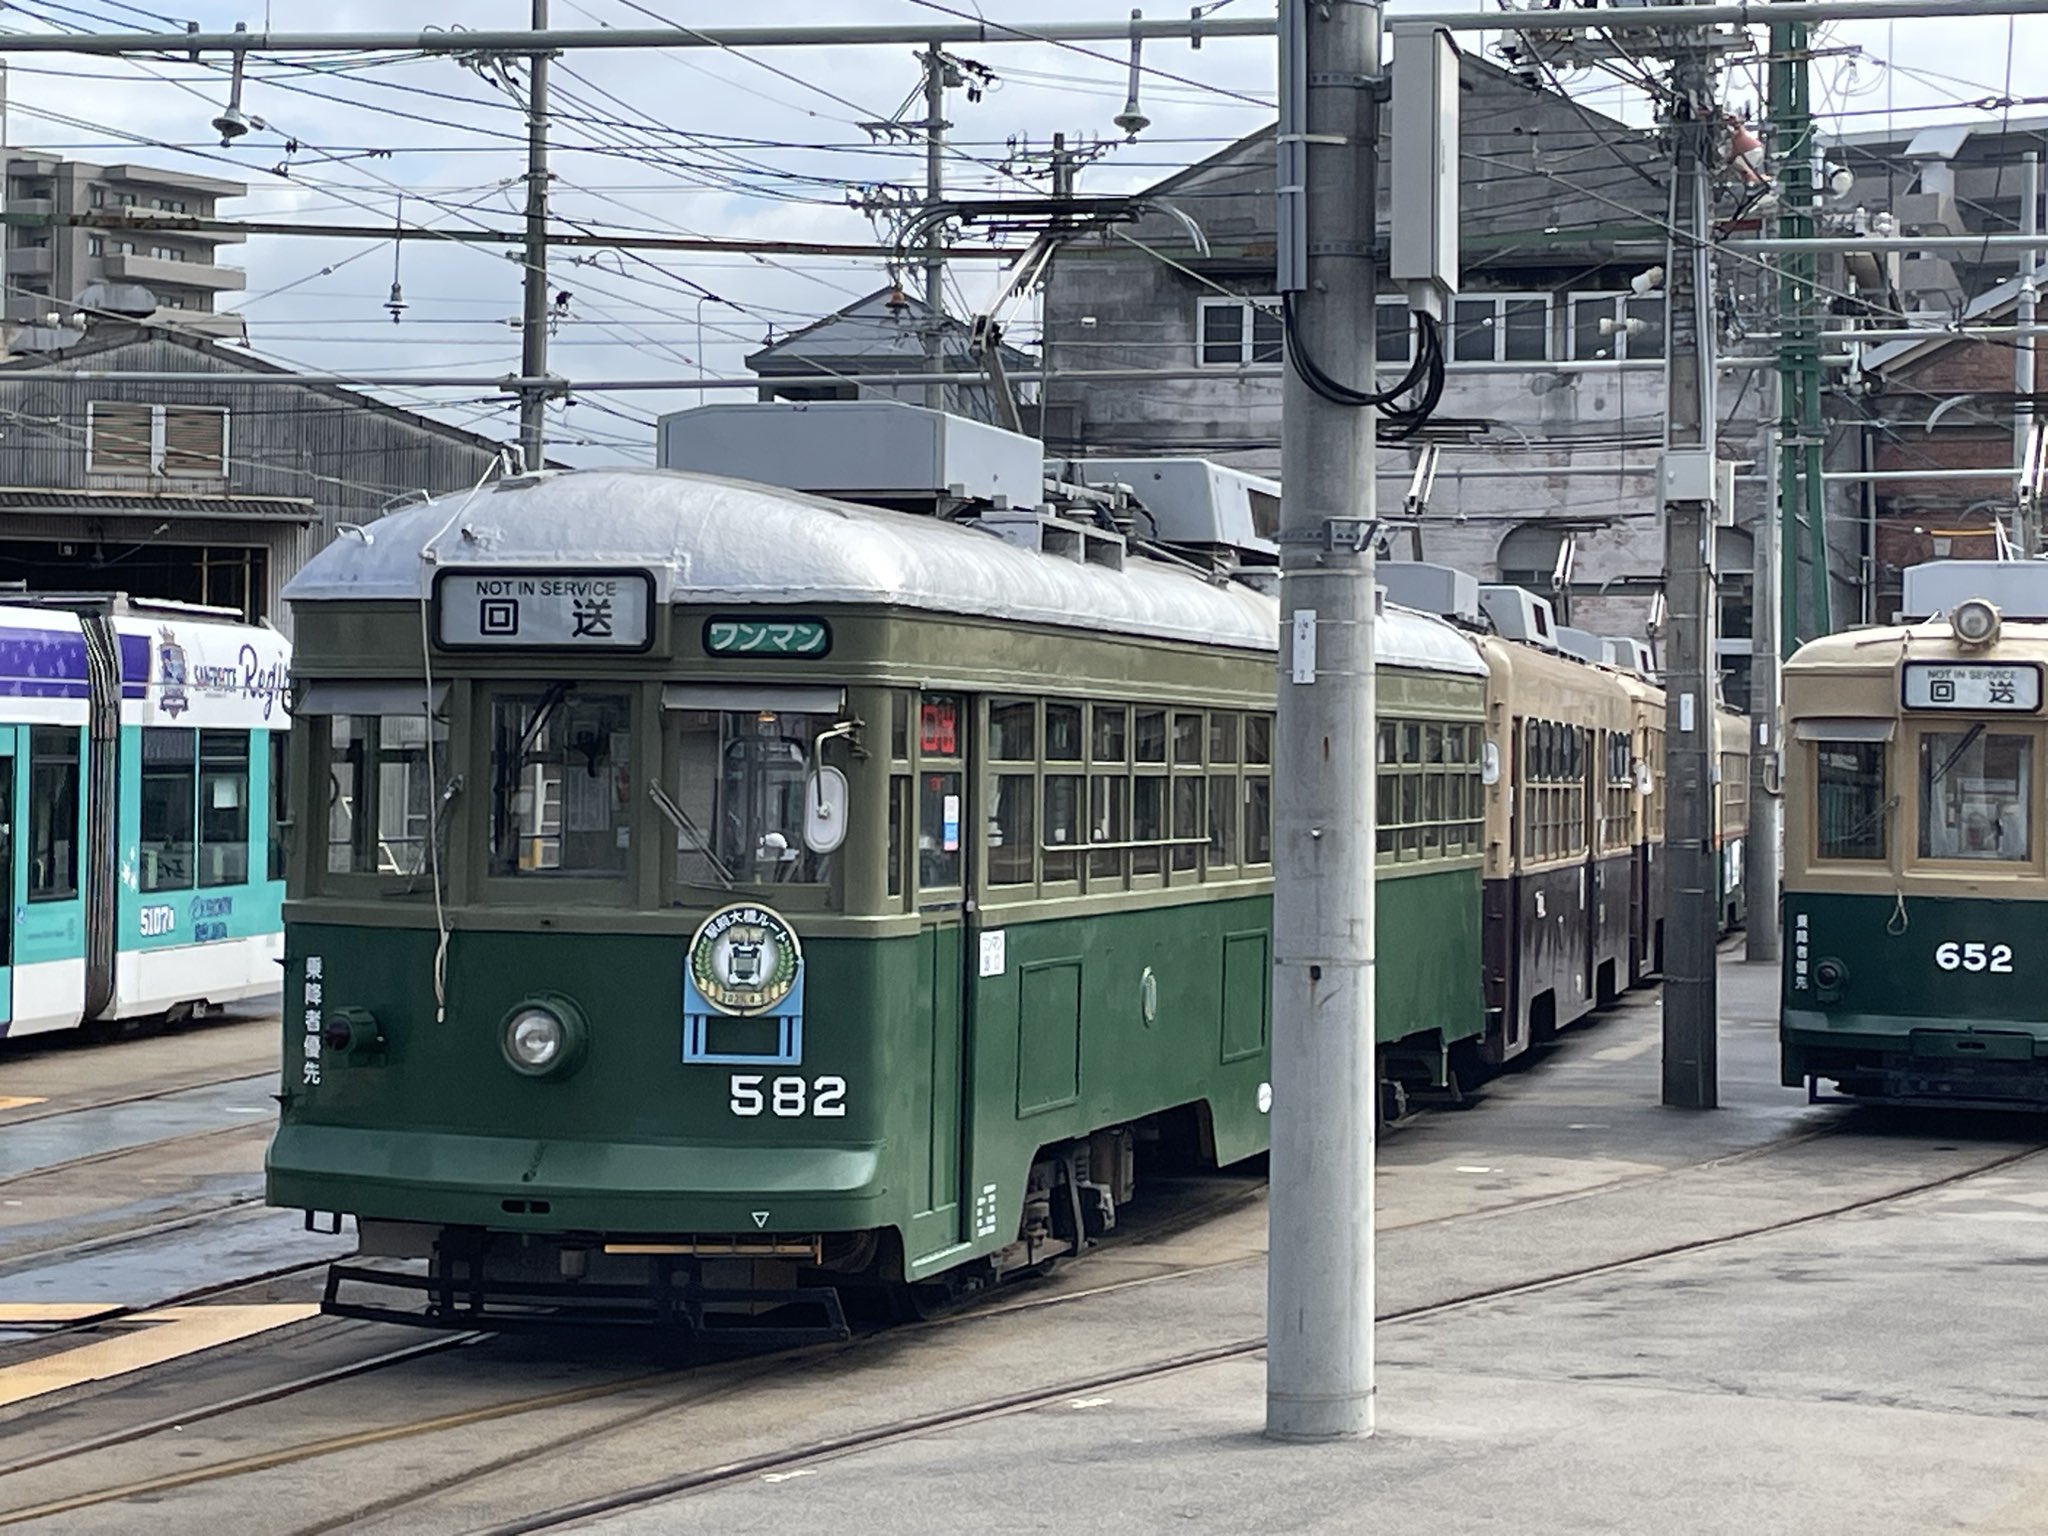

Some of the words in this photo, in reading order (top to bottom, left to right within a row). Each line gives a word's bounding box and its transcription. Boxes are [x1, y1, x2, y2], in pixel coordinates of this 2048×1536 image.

[476, 581, 513, 596] NOT
[518, 581, 535, 596] IN
[540, 581, 616, 596] SERVICE
[480, 598, 612, 637] 回送
[711, 623, 825, 651] ワンマン
[1928, 669, 1951, 679] NOT
[1954, 669, 1966, 679] IN
[1970, 670, 2016, 680] SERVICE
[1931, 680, 2015, 703] 回送
[1936, 942, 2013, 973] 652
[730, 1075, 846, 1117] 582
